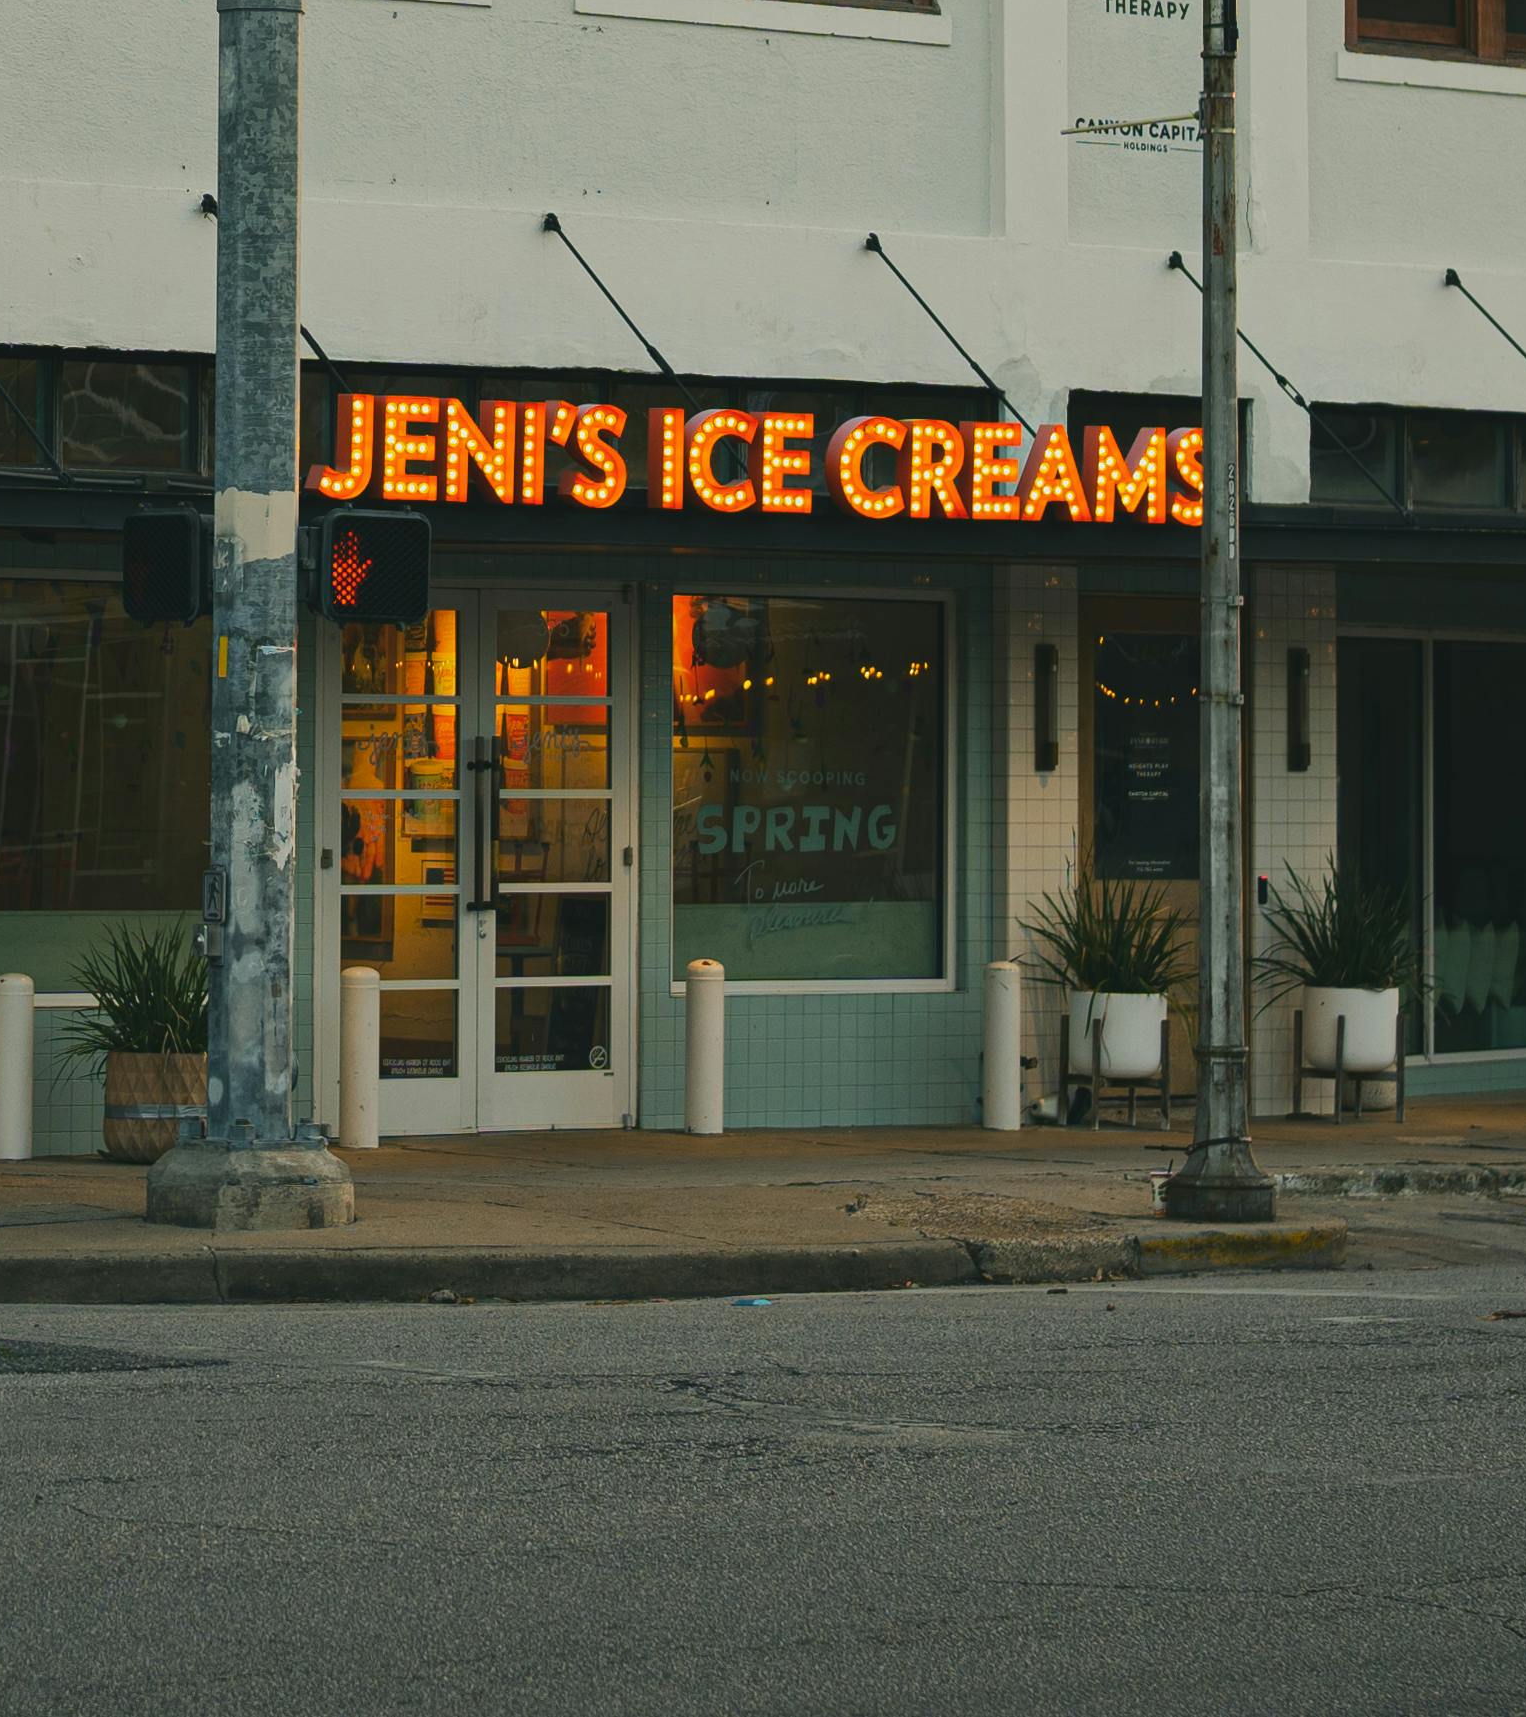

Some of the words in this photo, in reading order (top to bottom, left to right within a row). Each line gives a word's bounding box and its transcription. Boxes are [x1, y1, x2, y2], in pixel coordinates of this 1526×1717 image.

[1149, 123, 1204, 142] CAPITA
[1123, 141, 1168, 153] HOLDINGS
[308, 392, 627, 509] JENI'S
[650, 407, 816, 515] ICE
[830, 415, 1205, 527] CREAMS
[730, 768, 768, 783] NOW
[776, 770, 866, 786] SCOOPING
[696, 803, 897, 855] SPRING
